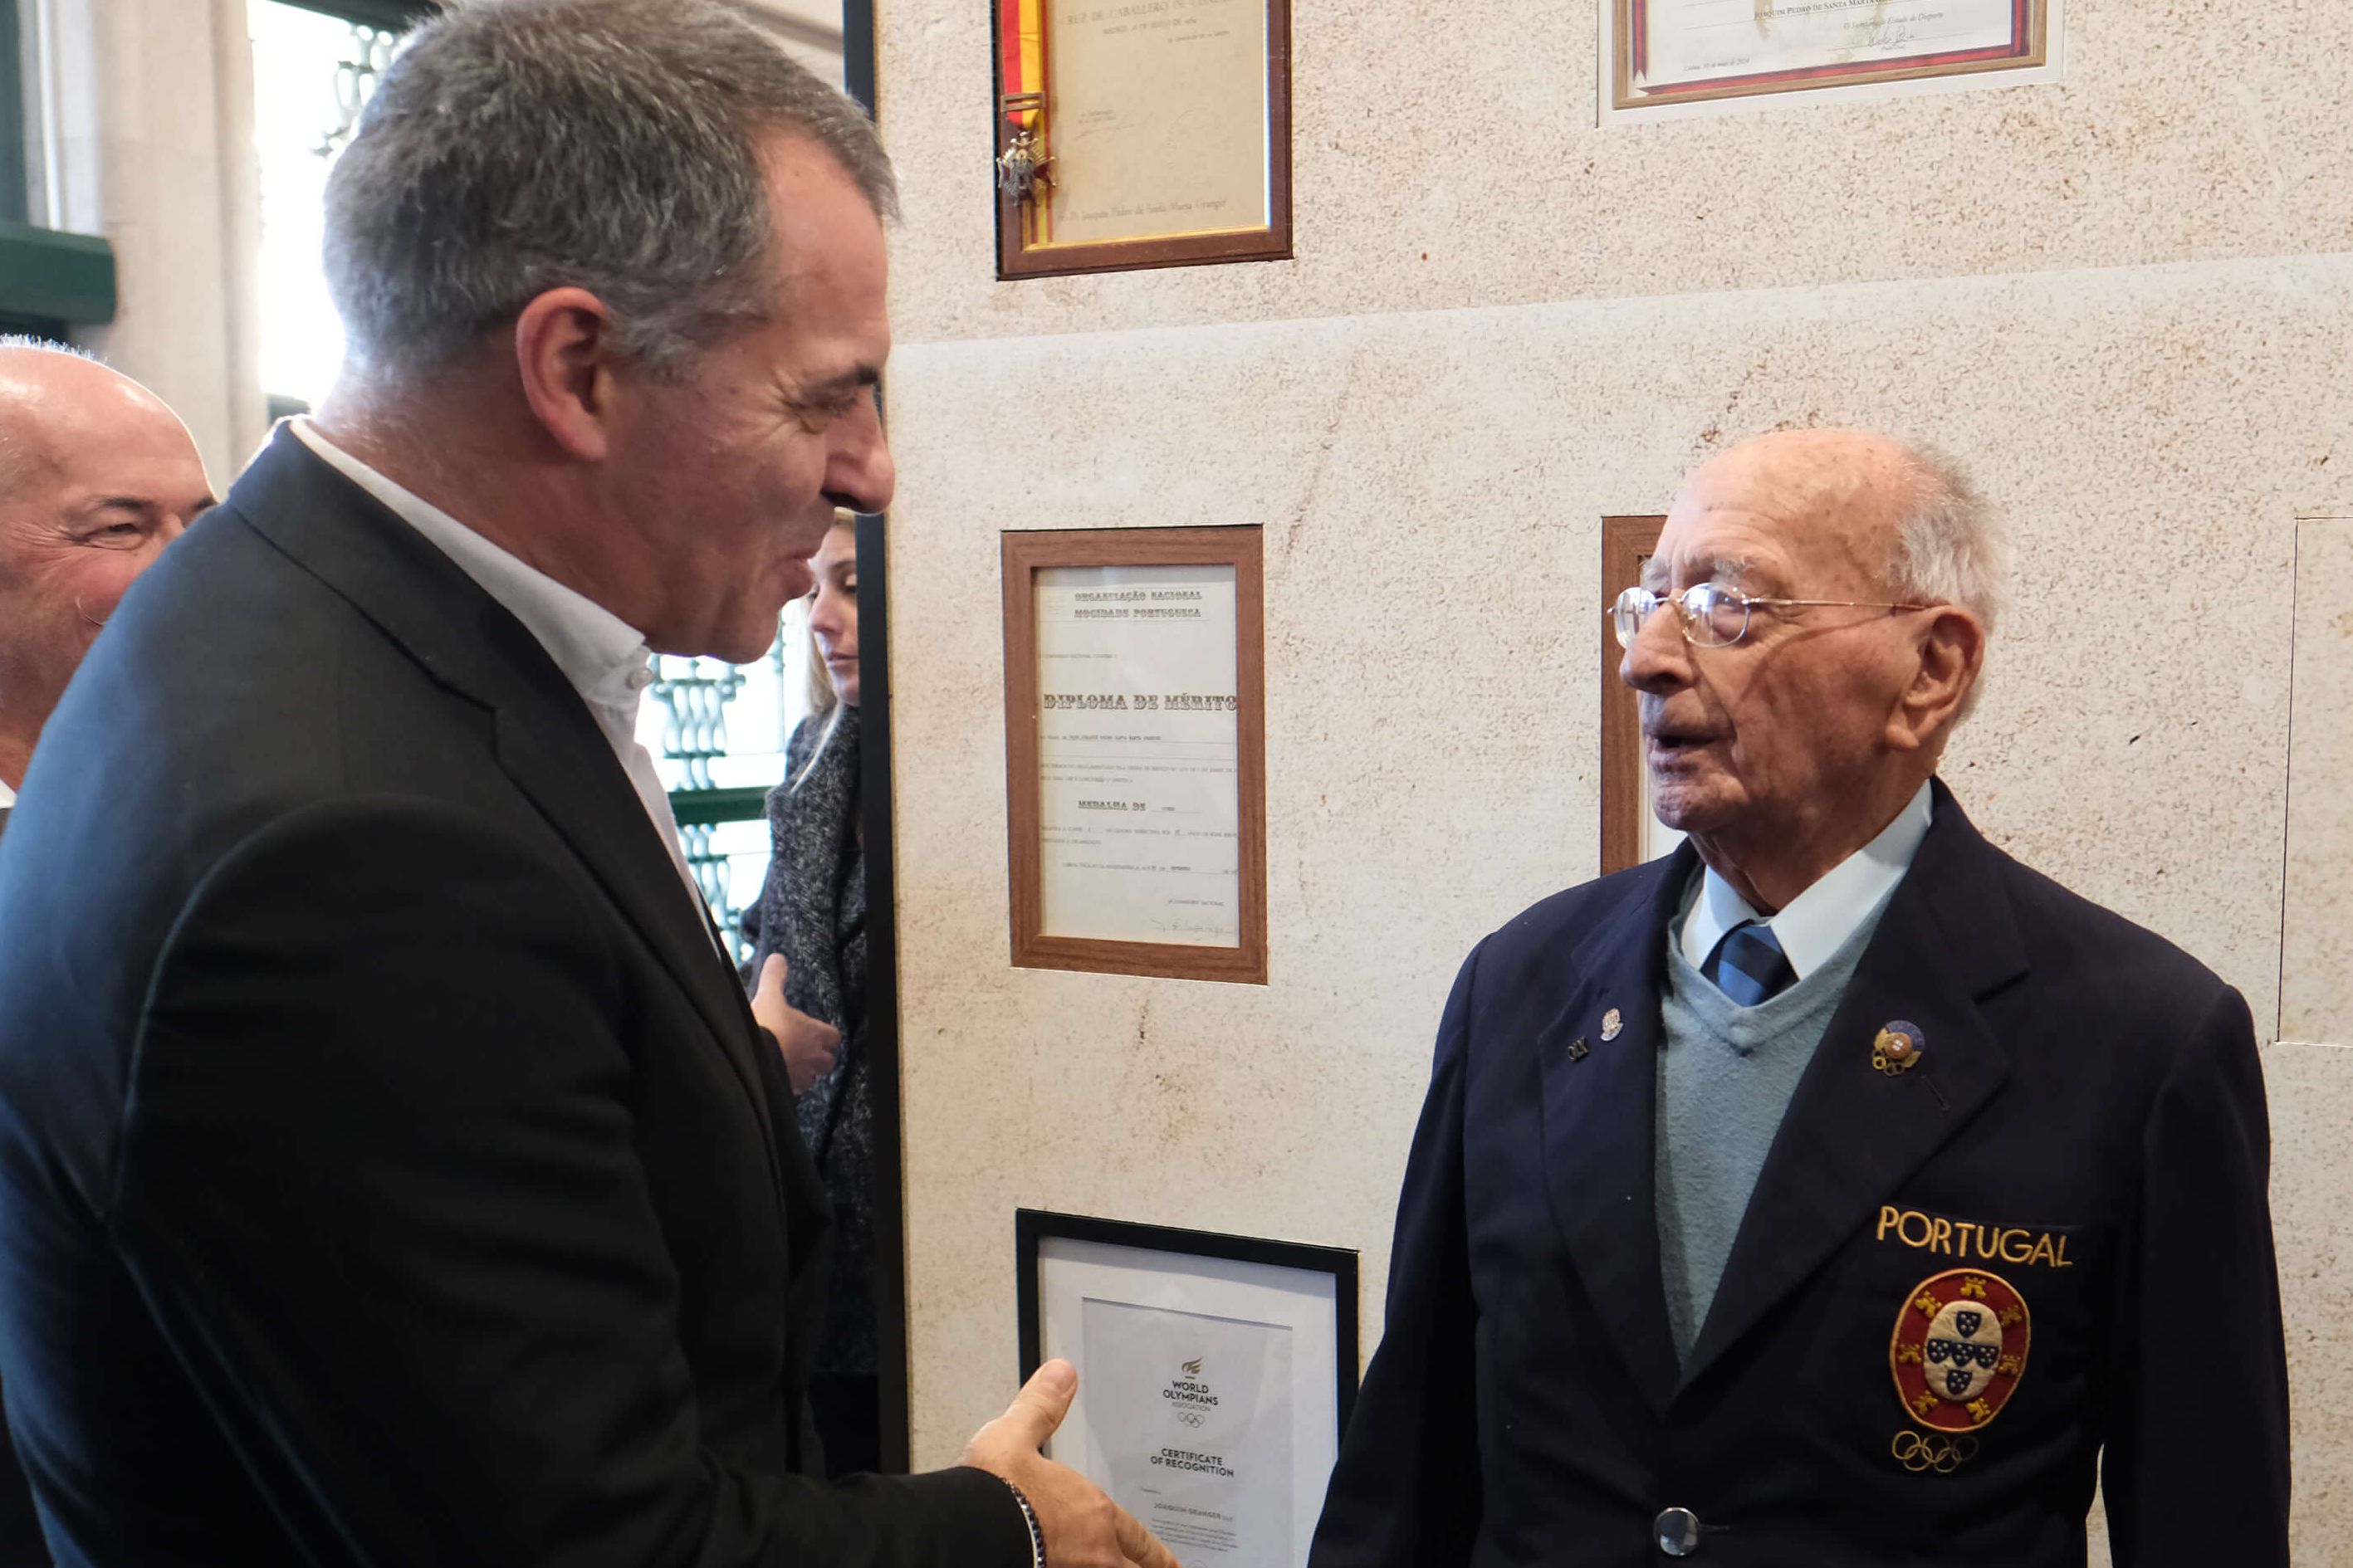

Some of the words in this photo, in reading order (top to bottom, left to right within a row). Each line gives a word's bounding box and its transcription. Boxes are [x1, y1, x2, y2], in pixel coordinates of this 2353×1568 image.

[1074, 608, 1129, 618] MOCIDADE
[1043, 694, 1128, 710] DIPLOMA
[1133, 694, 1159, 710] DE
[1164, 692, 1237, 711] MÉRITO
[1078, 800, 1128, 811] MEDALHA
[1132, 802, 1147, 811] DE
[1876, 1204, 2074, 1268] PORTUGAL
[1172, 1380, 1209, 1394] WORLD
[1162, 1389, 1219, 1405] OLYMPIANS
[1161, 1448, 1223, 1466] CERTIFICATE
[1150, 1455, 1163, 1465] OF
[1165, 1458, 1235, 1478] RECOGNITION
